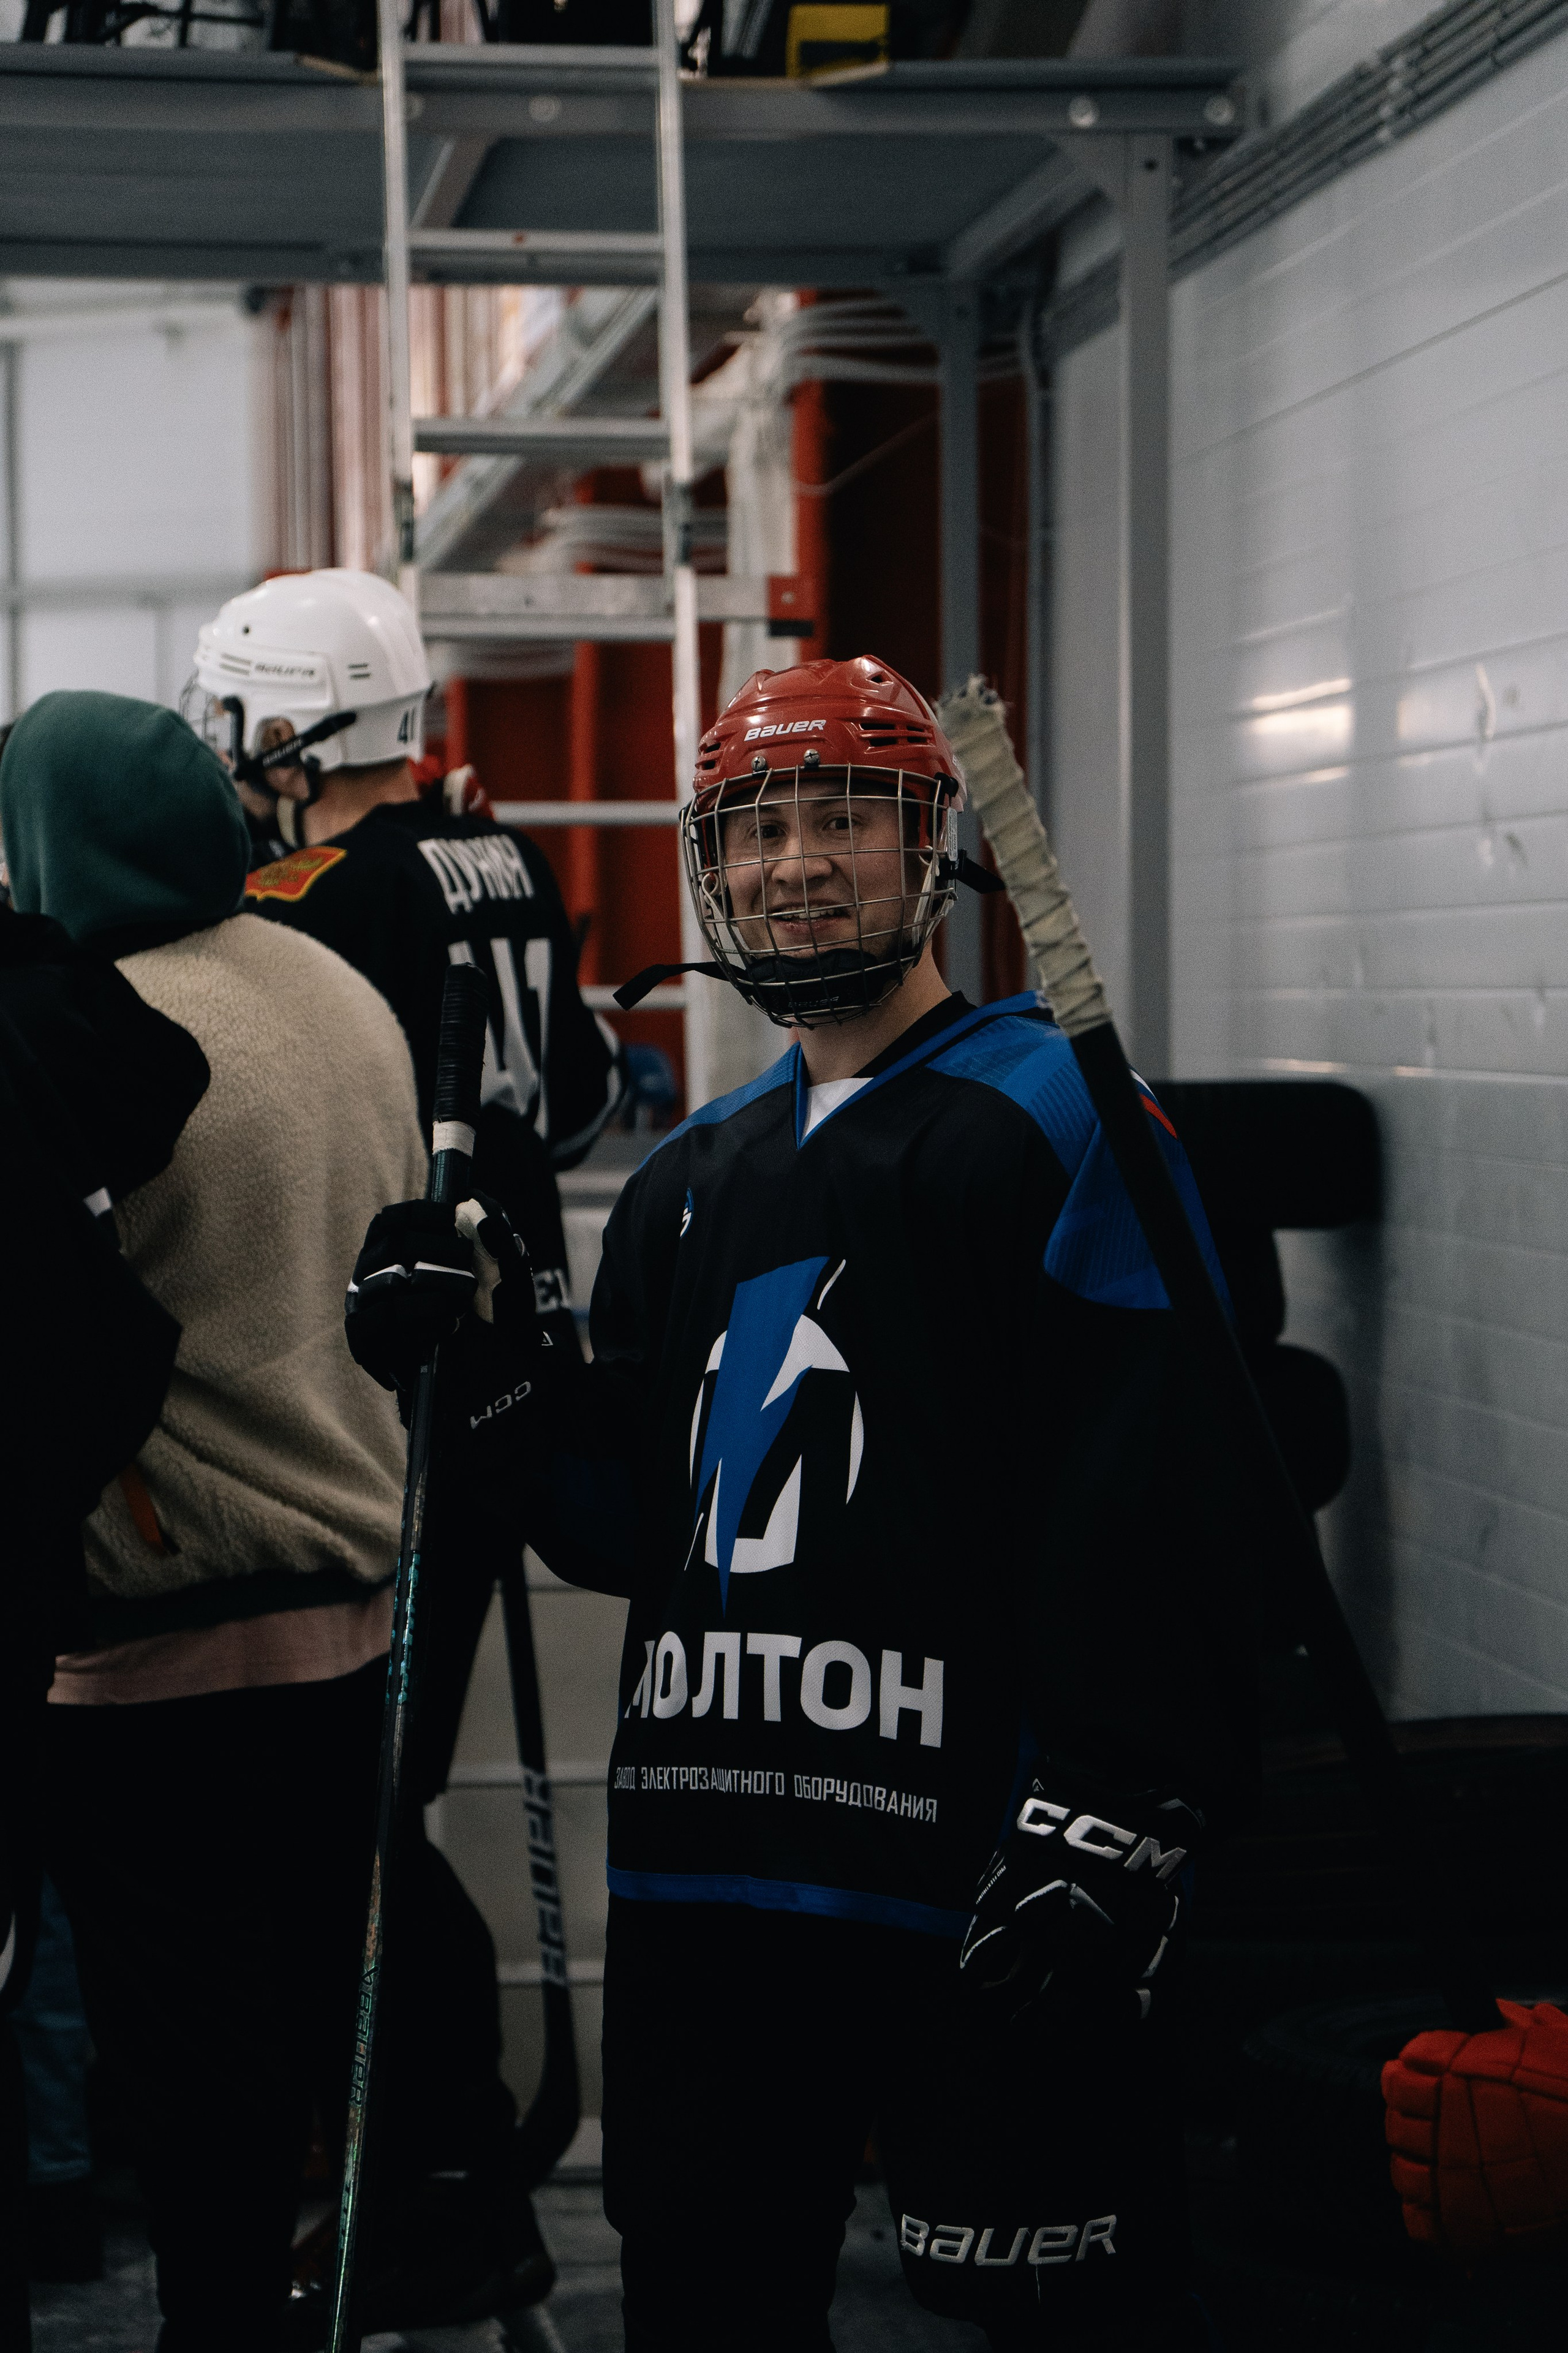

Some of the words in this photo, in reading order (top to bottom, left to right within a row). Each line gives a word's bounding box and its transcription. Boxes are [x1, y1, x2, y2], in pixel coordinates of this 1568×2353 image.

[397, 708, 415, 744] 41
[470, 1380, 532, 1429] CCM
[614, 1767, 636, 1791] ЗАВОД
[641, 1766, 785, 1796] ЭЛЕКТРОЗАЩИТНОГО
[794, 1773, 937, 1823] ОБОРУДОВАНИЯ
[1017, 1797, 1187, 1879] CCM
